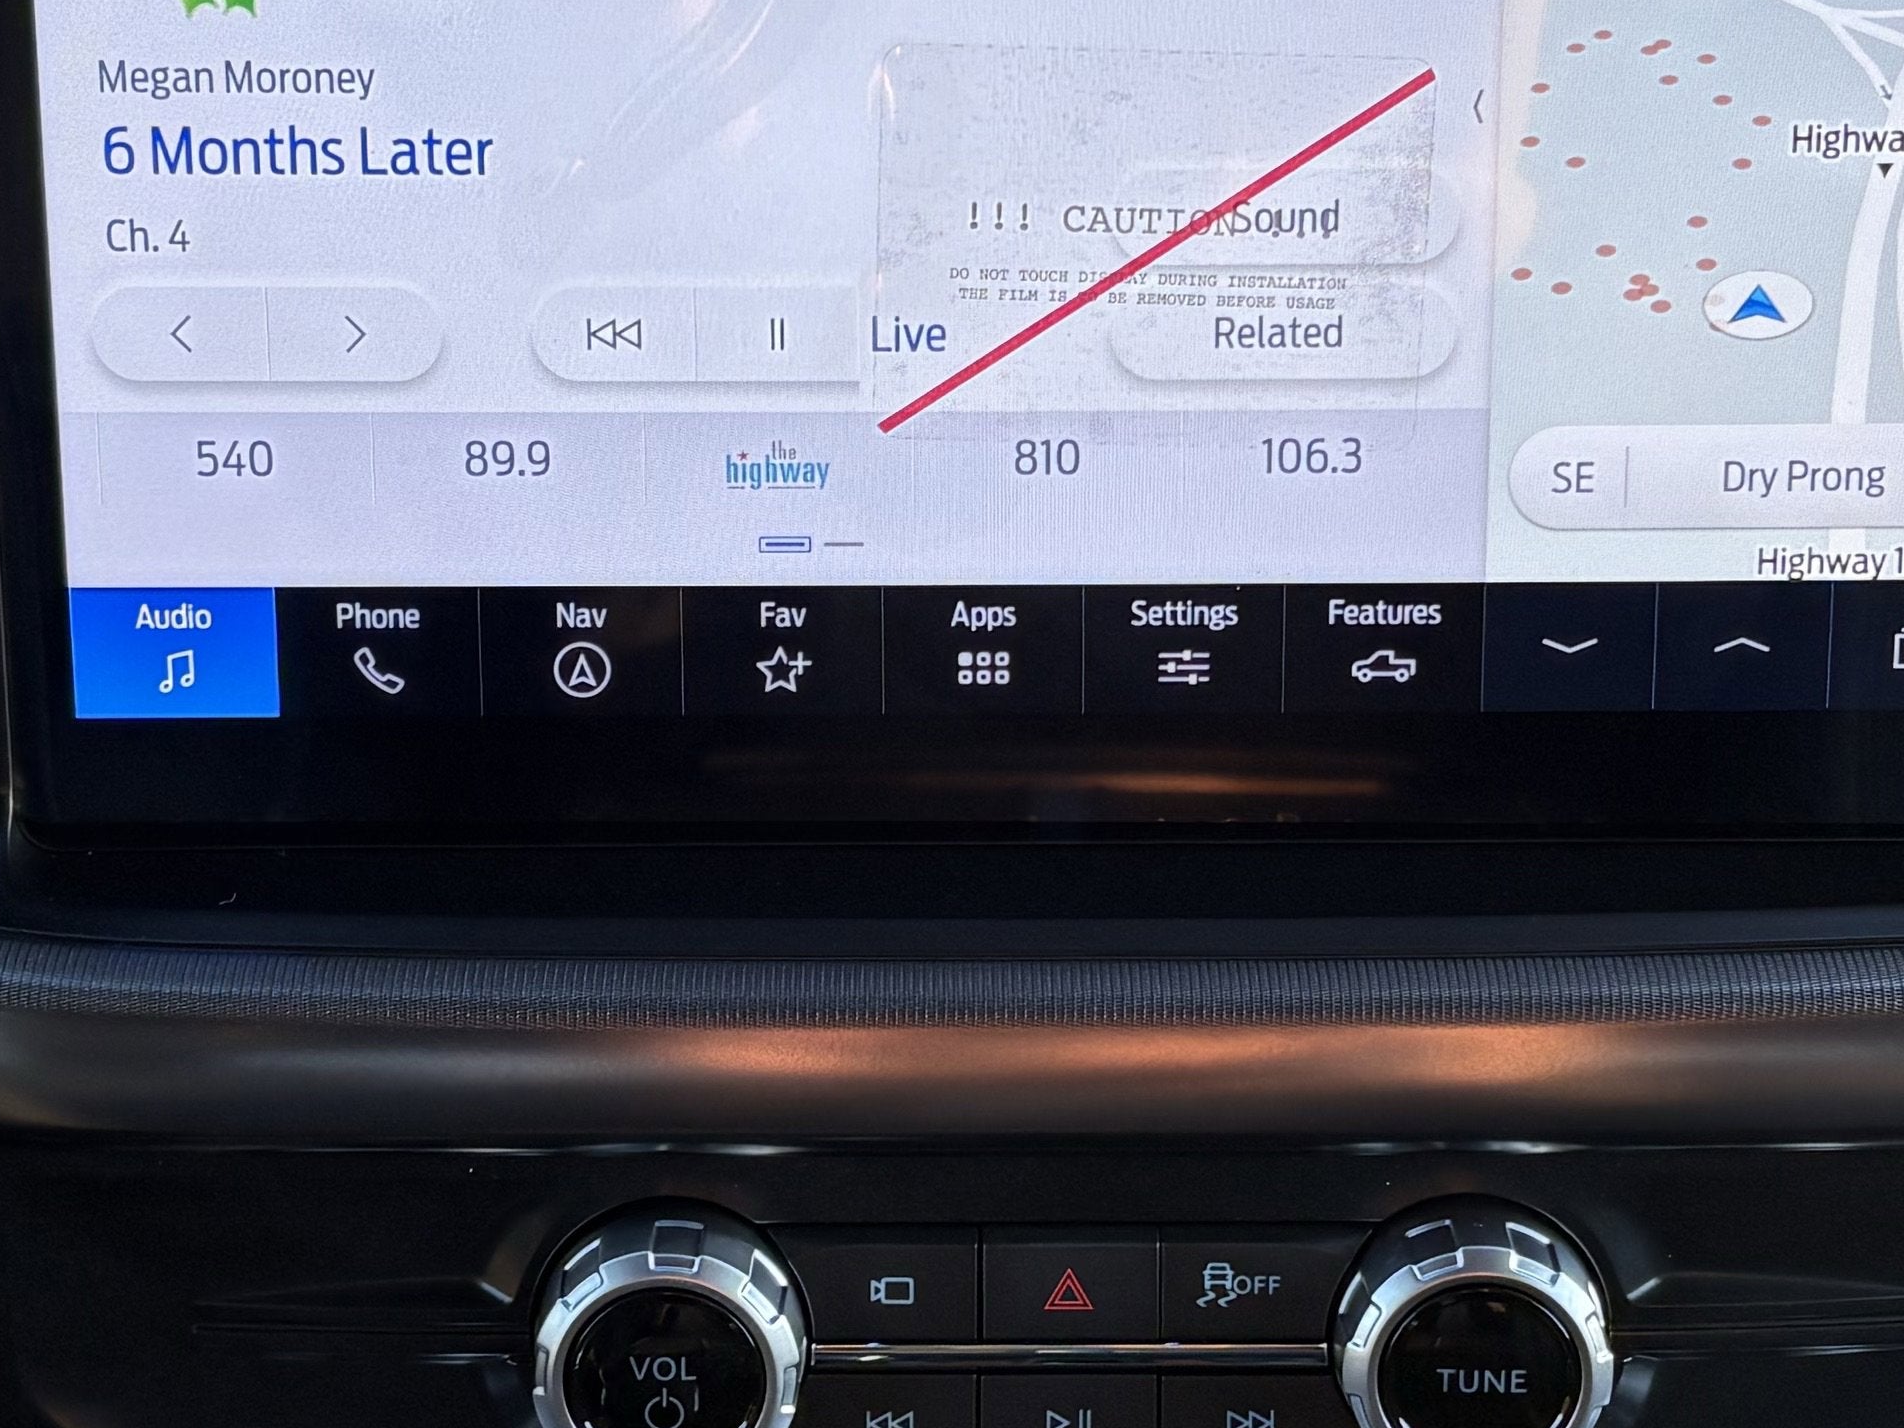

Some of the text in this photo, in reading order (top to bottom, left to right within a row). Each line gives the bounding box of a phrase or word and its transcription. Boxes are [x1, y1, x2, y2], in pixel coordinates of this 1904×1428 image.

[98, 61, 375, 100] Megan Moroney
[103, 127, 494, 177] 6 Months Later
[1062, 204, 1237, 238] CAUTION
[1233, 199, 1339, 234] Sound
[106, 219, 191, 254] Ch. 4
[950, 268, 969, 279] DO
[980, 269, 1008, 280] NOT
[1019, 270, 1068, 282] TOUCH
[1158, 274, 1217, 287] DURING
[1228, 276, 1347, 290] INSTALLATION
[959, 288, 988, 300] THE
[999, 289, 1038, 302] FILM
[1049, 290, 1067, 302] IS
[1108, 292, 1127, 304] BE
[1136, 293, 1206, 306] REMOVED
[1217, 295, 1276, 308] BEFORE
[1287, 296, 1336, 310] USAGE
[872, 315, 946, 352] Live
[1214, 315, 1343, 349] Related
[196, 441, 275, 477] 540
[464, 441, 552, 477] 89.9
[772, 440, 797, 460] the
[1014, 440, 1080, 475] 810
[1262, 438, 1363, 474] 106.3
[726, 454, 830, 490] highway
[1551, 460, 1886, 497] SE Dry Prong
[1756, 547, 1887, 580] Highway
[135, 602, 213, 632] Audio
[335, 601, 421, 632] Phone
[555, 602, 608, 630] Nav
[758, 602, 808, 630] Fav
[950, 601, 1018, 636] Apps
[1130, 599, 1240, 632] Settings
[1327, 597, 1443, 628] Features
[1233, 1274, 1281, 1295] OFF
[629, 1356, 697, 1381] VOL
[1436, 1369, 1527, 1393] TUNE
